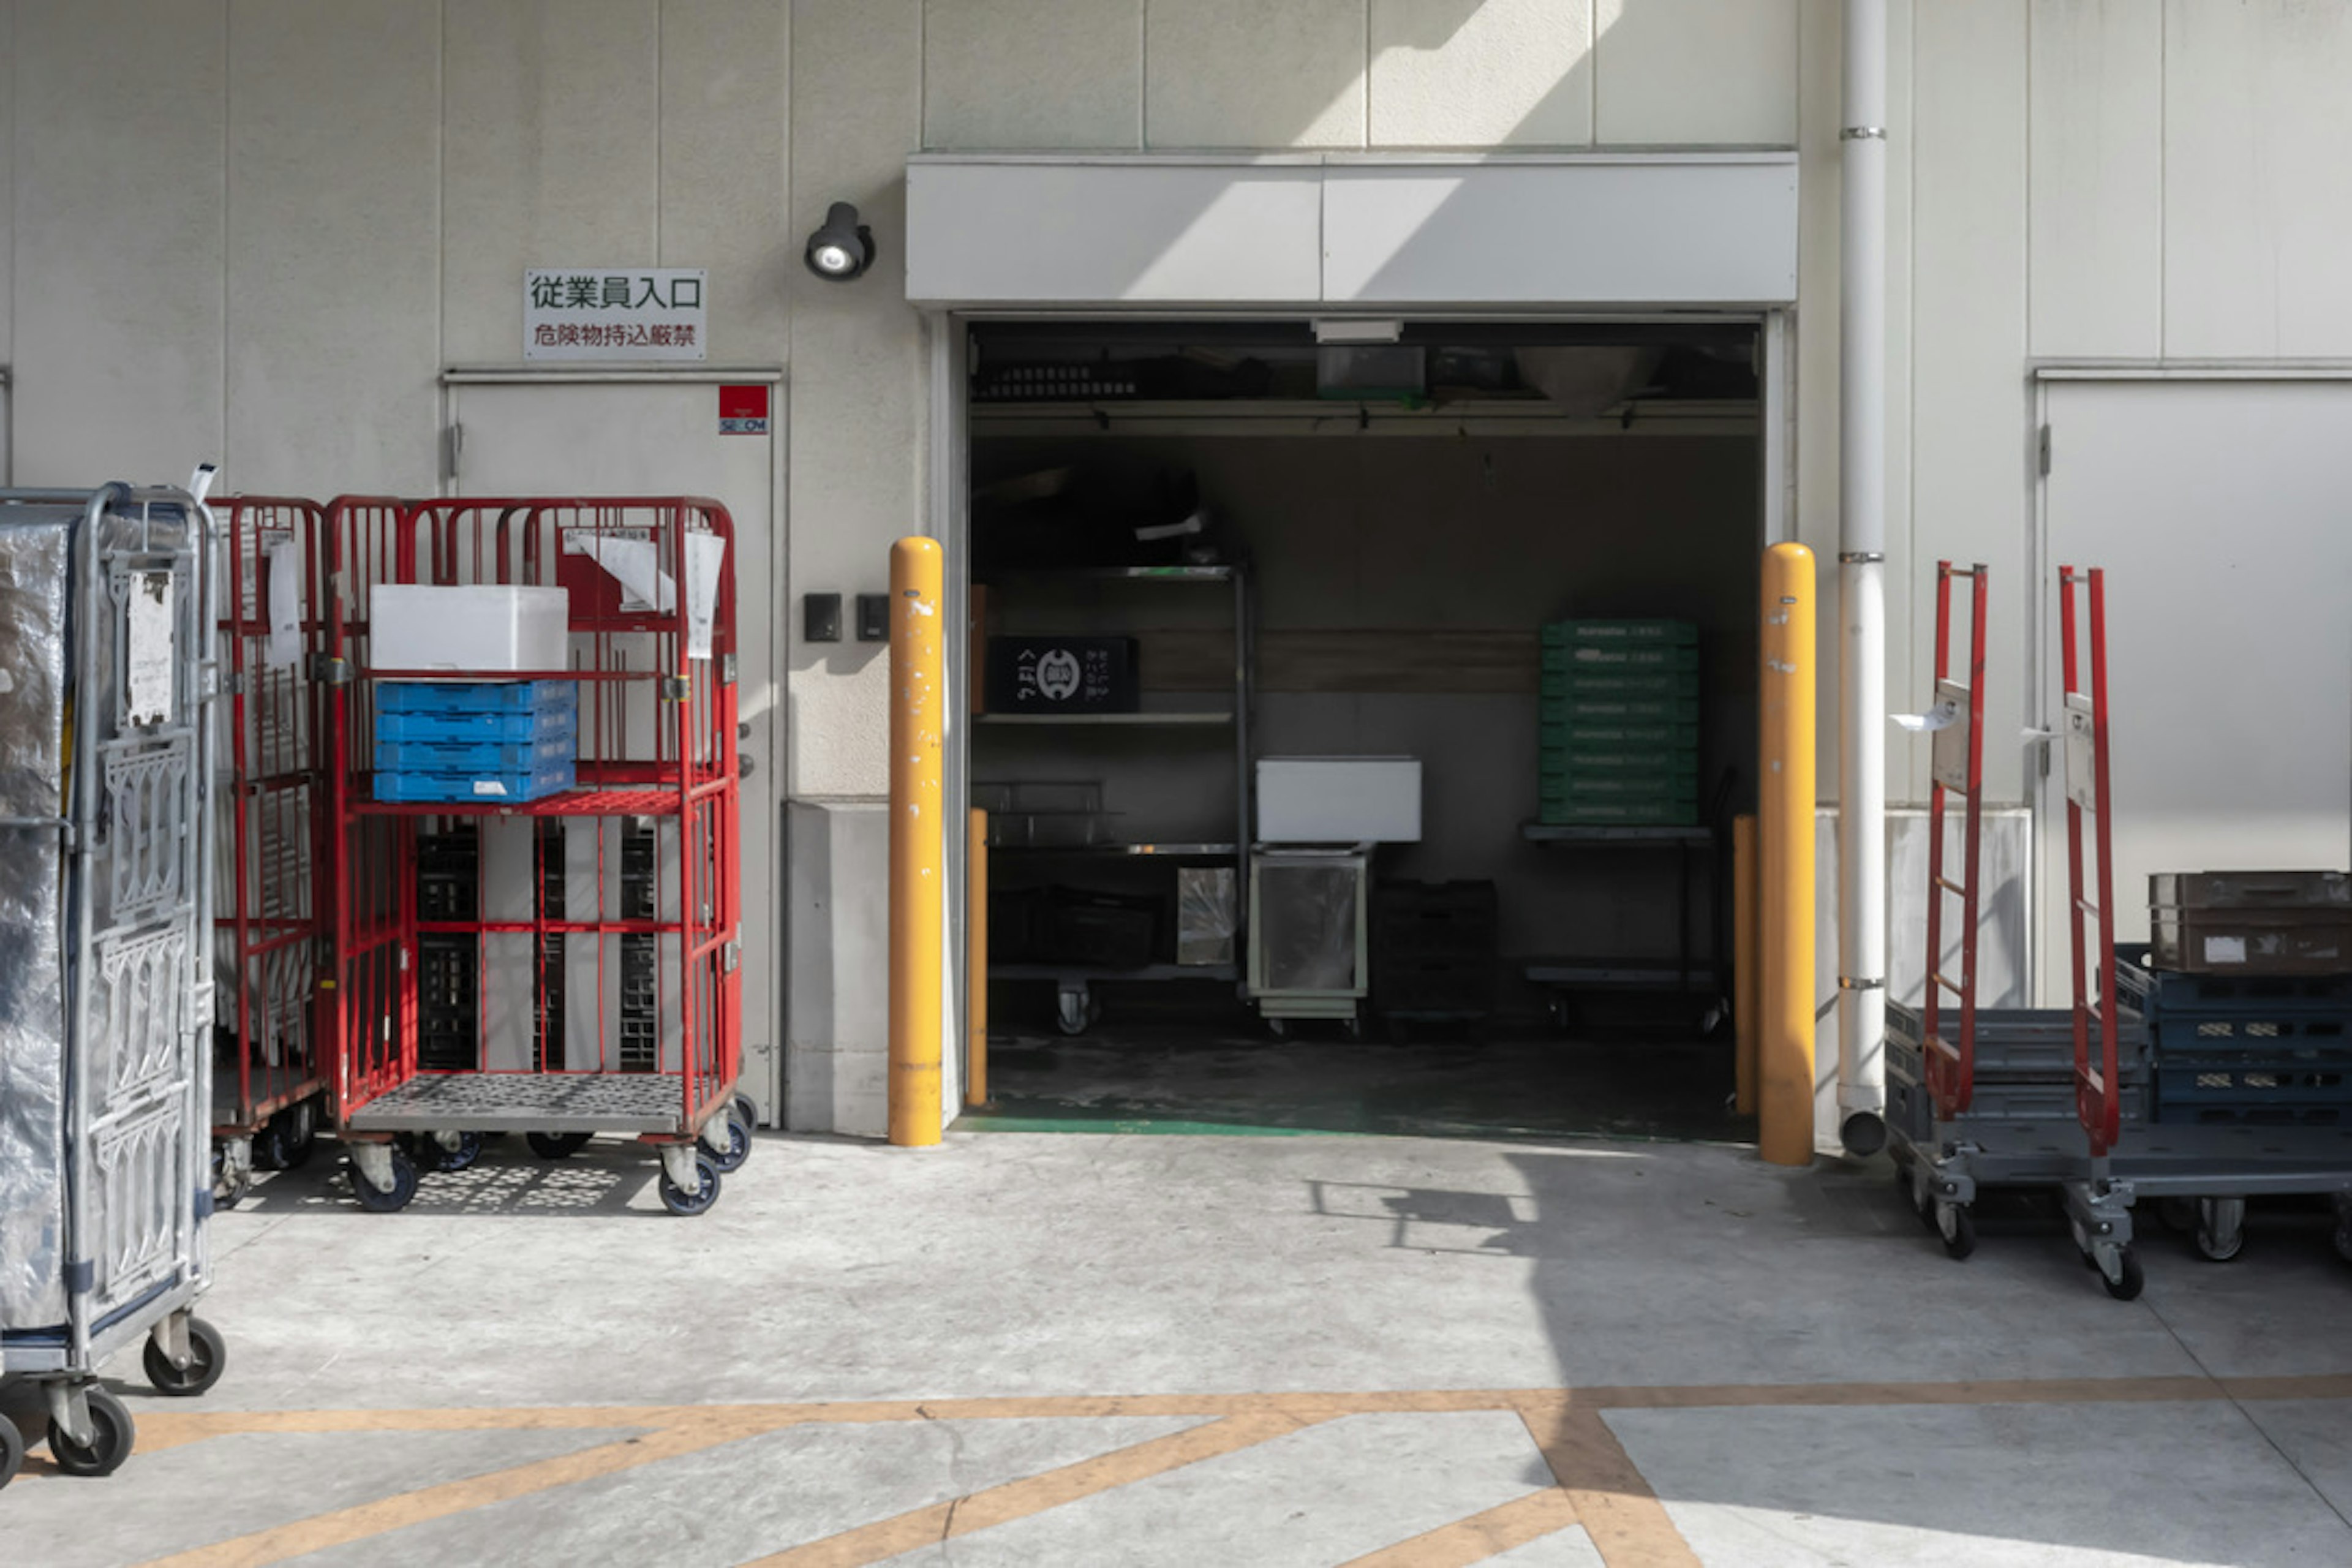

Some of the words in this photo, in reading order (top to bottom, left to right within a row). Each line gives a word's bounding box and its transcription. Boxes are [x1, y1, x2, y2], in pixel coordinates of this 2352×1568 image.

[530, 275, 700, 309] 従業員入口
[535, 323, 695, 347] 危険物持込厳禁
[1017, 648, 1036, 701] くばら
